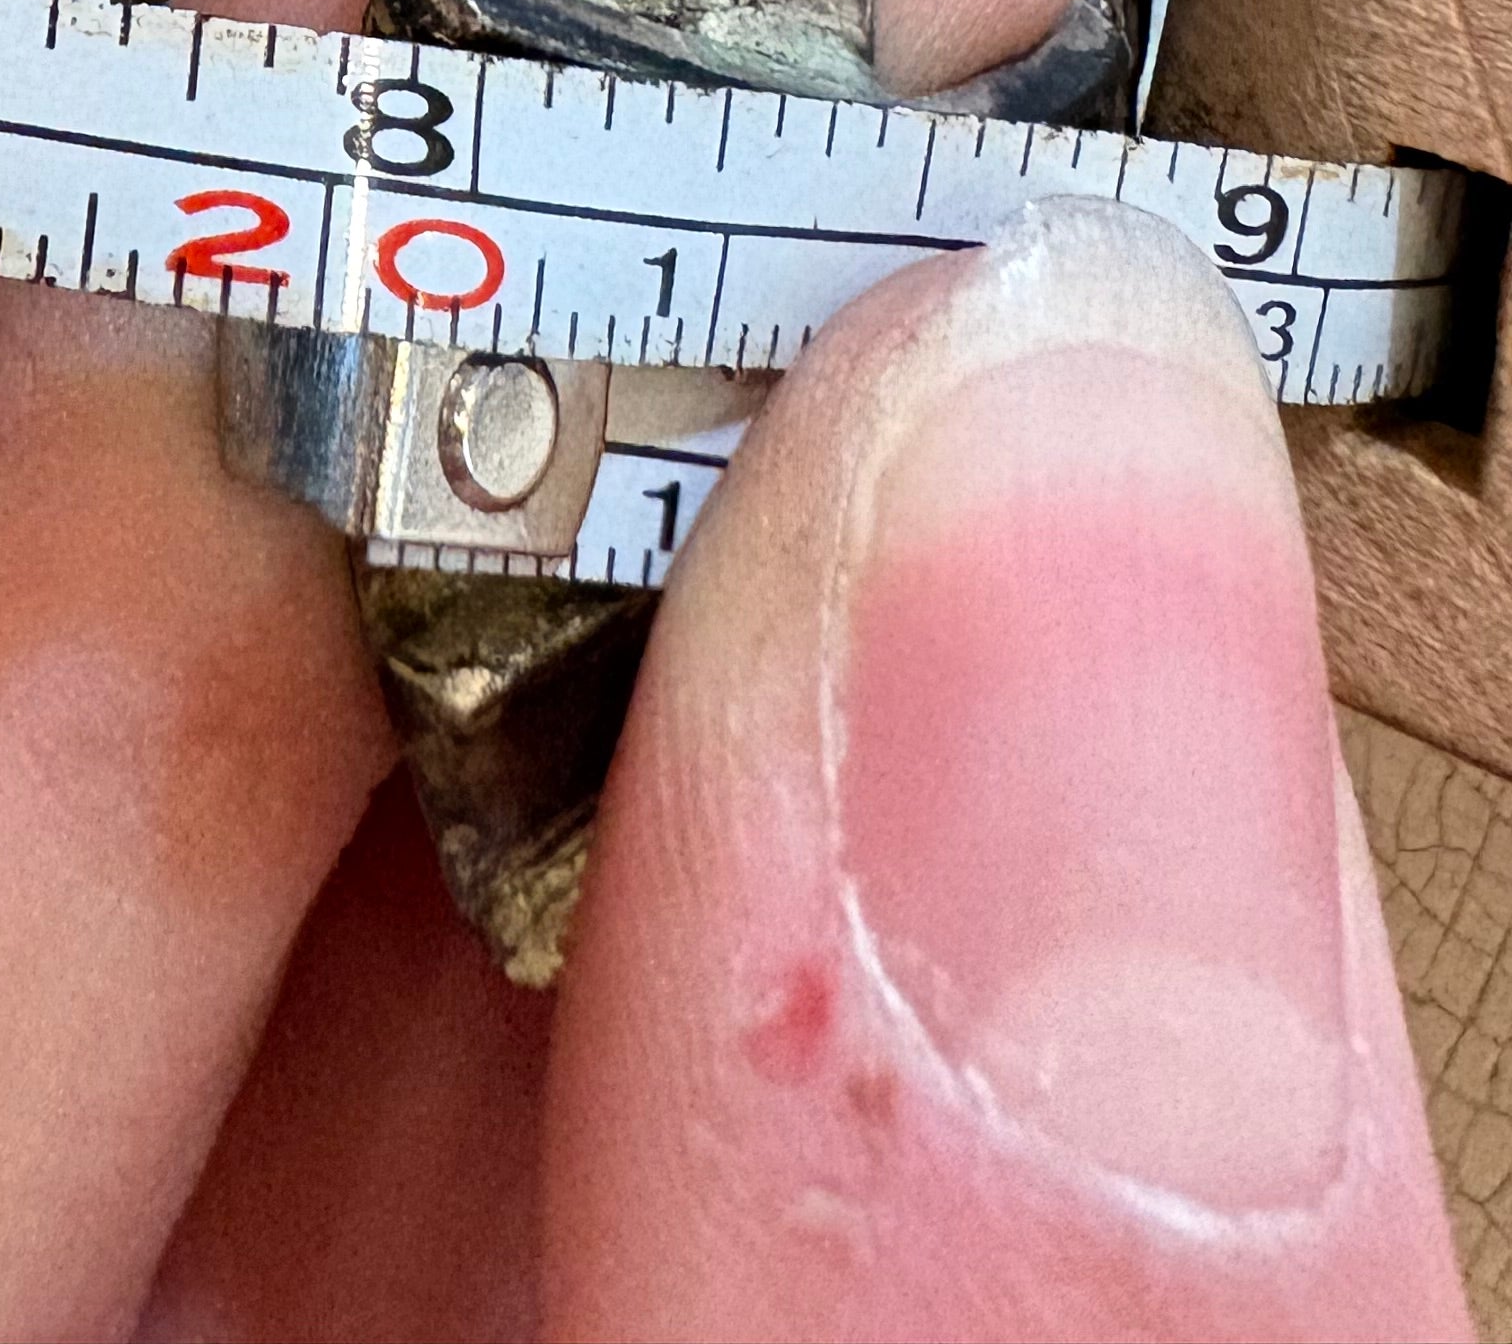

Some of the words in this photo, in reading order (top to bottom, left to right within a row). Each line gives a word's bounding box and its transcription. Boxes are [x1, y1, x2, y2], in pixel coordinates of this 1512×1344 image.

[343, 78, 455, 176] 8
[1213, 184, 1289, 264] 9
[643, 247, 678, 318] 1
[1255, 300, 1297, 361] 3
[642, 481, 681, 552] 1
